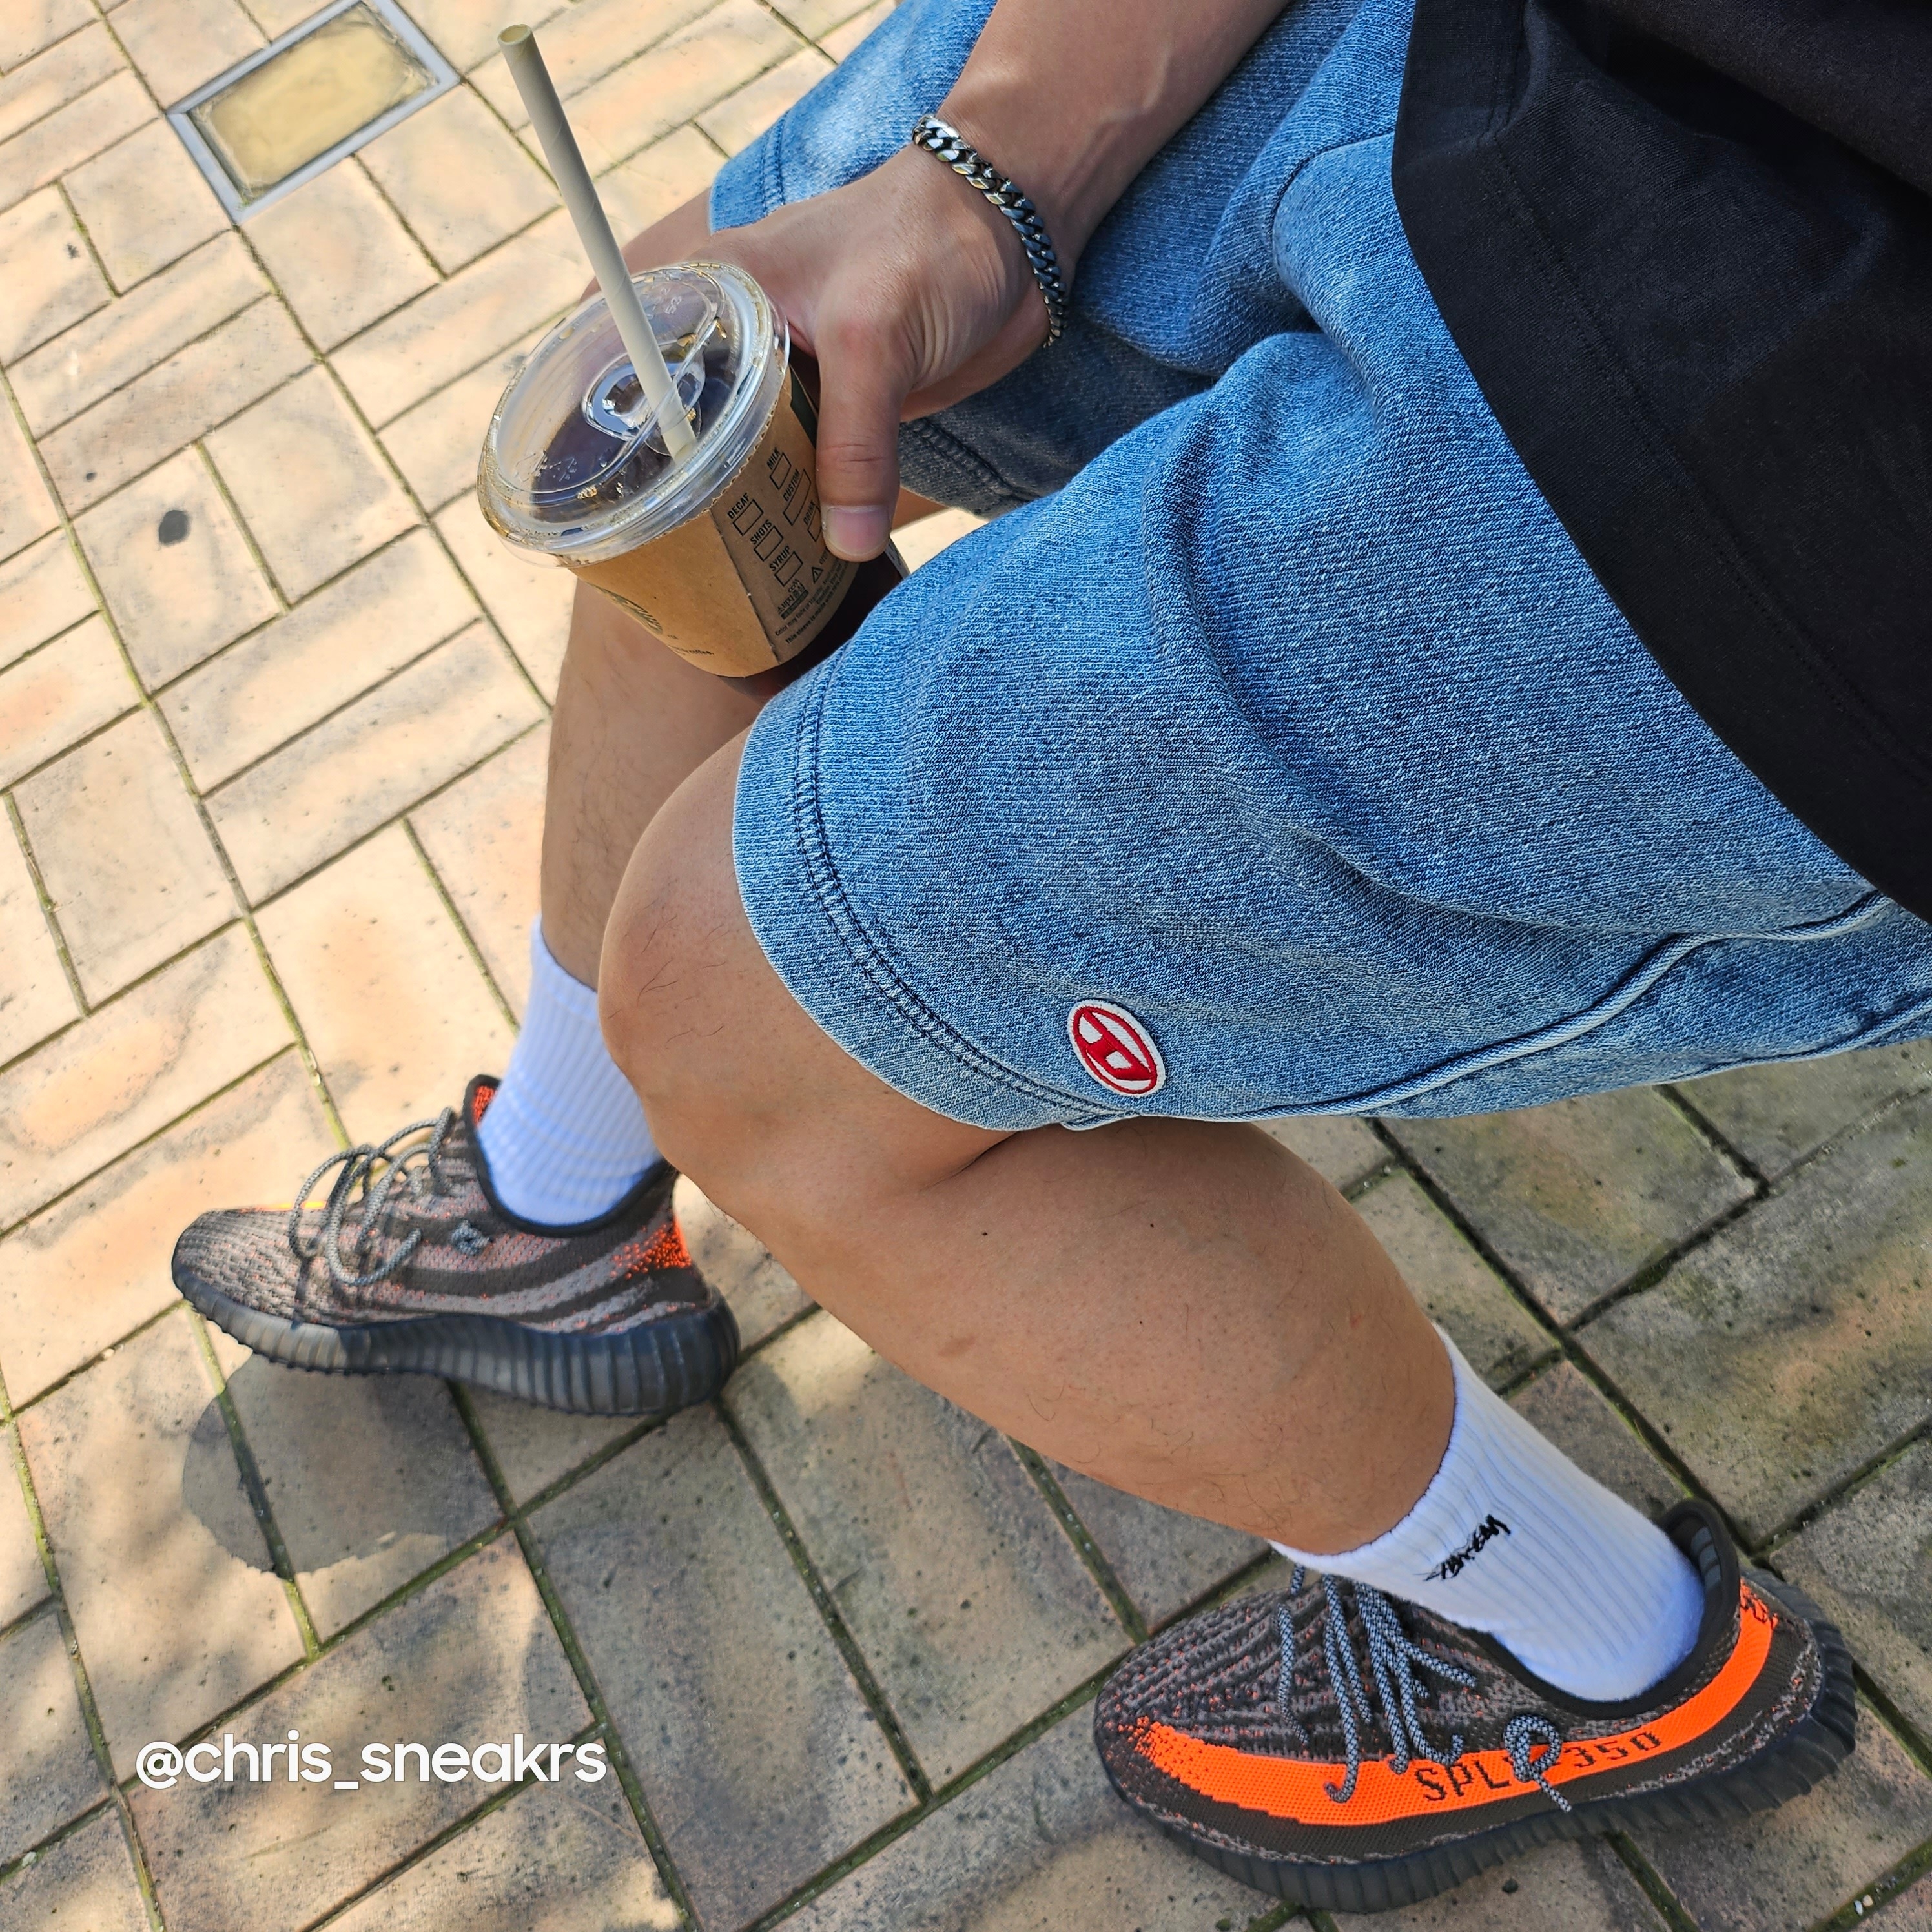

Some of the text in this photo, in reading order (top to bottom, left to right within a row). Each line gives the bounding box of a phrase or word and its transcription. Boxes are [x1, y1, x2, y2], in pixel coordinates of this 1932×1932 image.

[766, 447, 781, 469] MILK
[783, 469, 801, 501] CUSTOM
[727, 492, 750, 519] DECAF
[803, 500, 816, 526] DRINK
[750, 519, 772, 545] SHOTS
[769, 545, 791, 572] SYRUP
[785, 633, 798, 644] This
